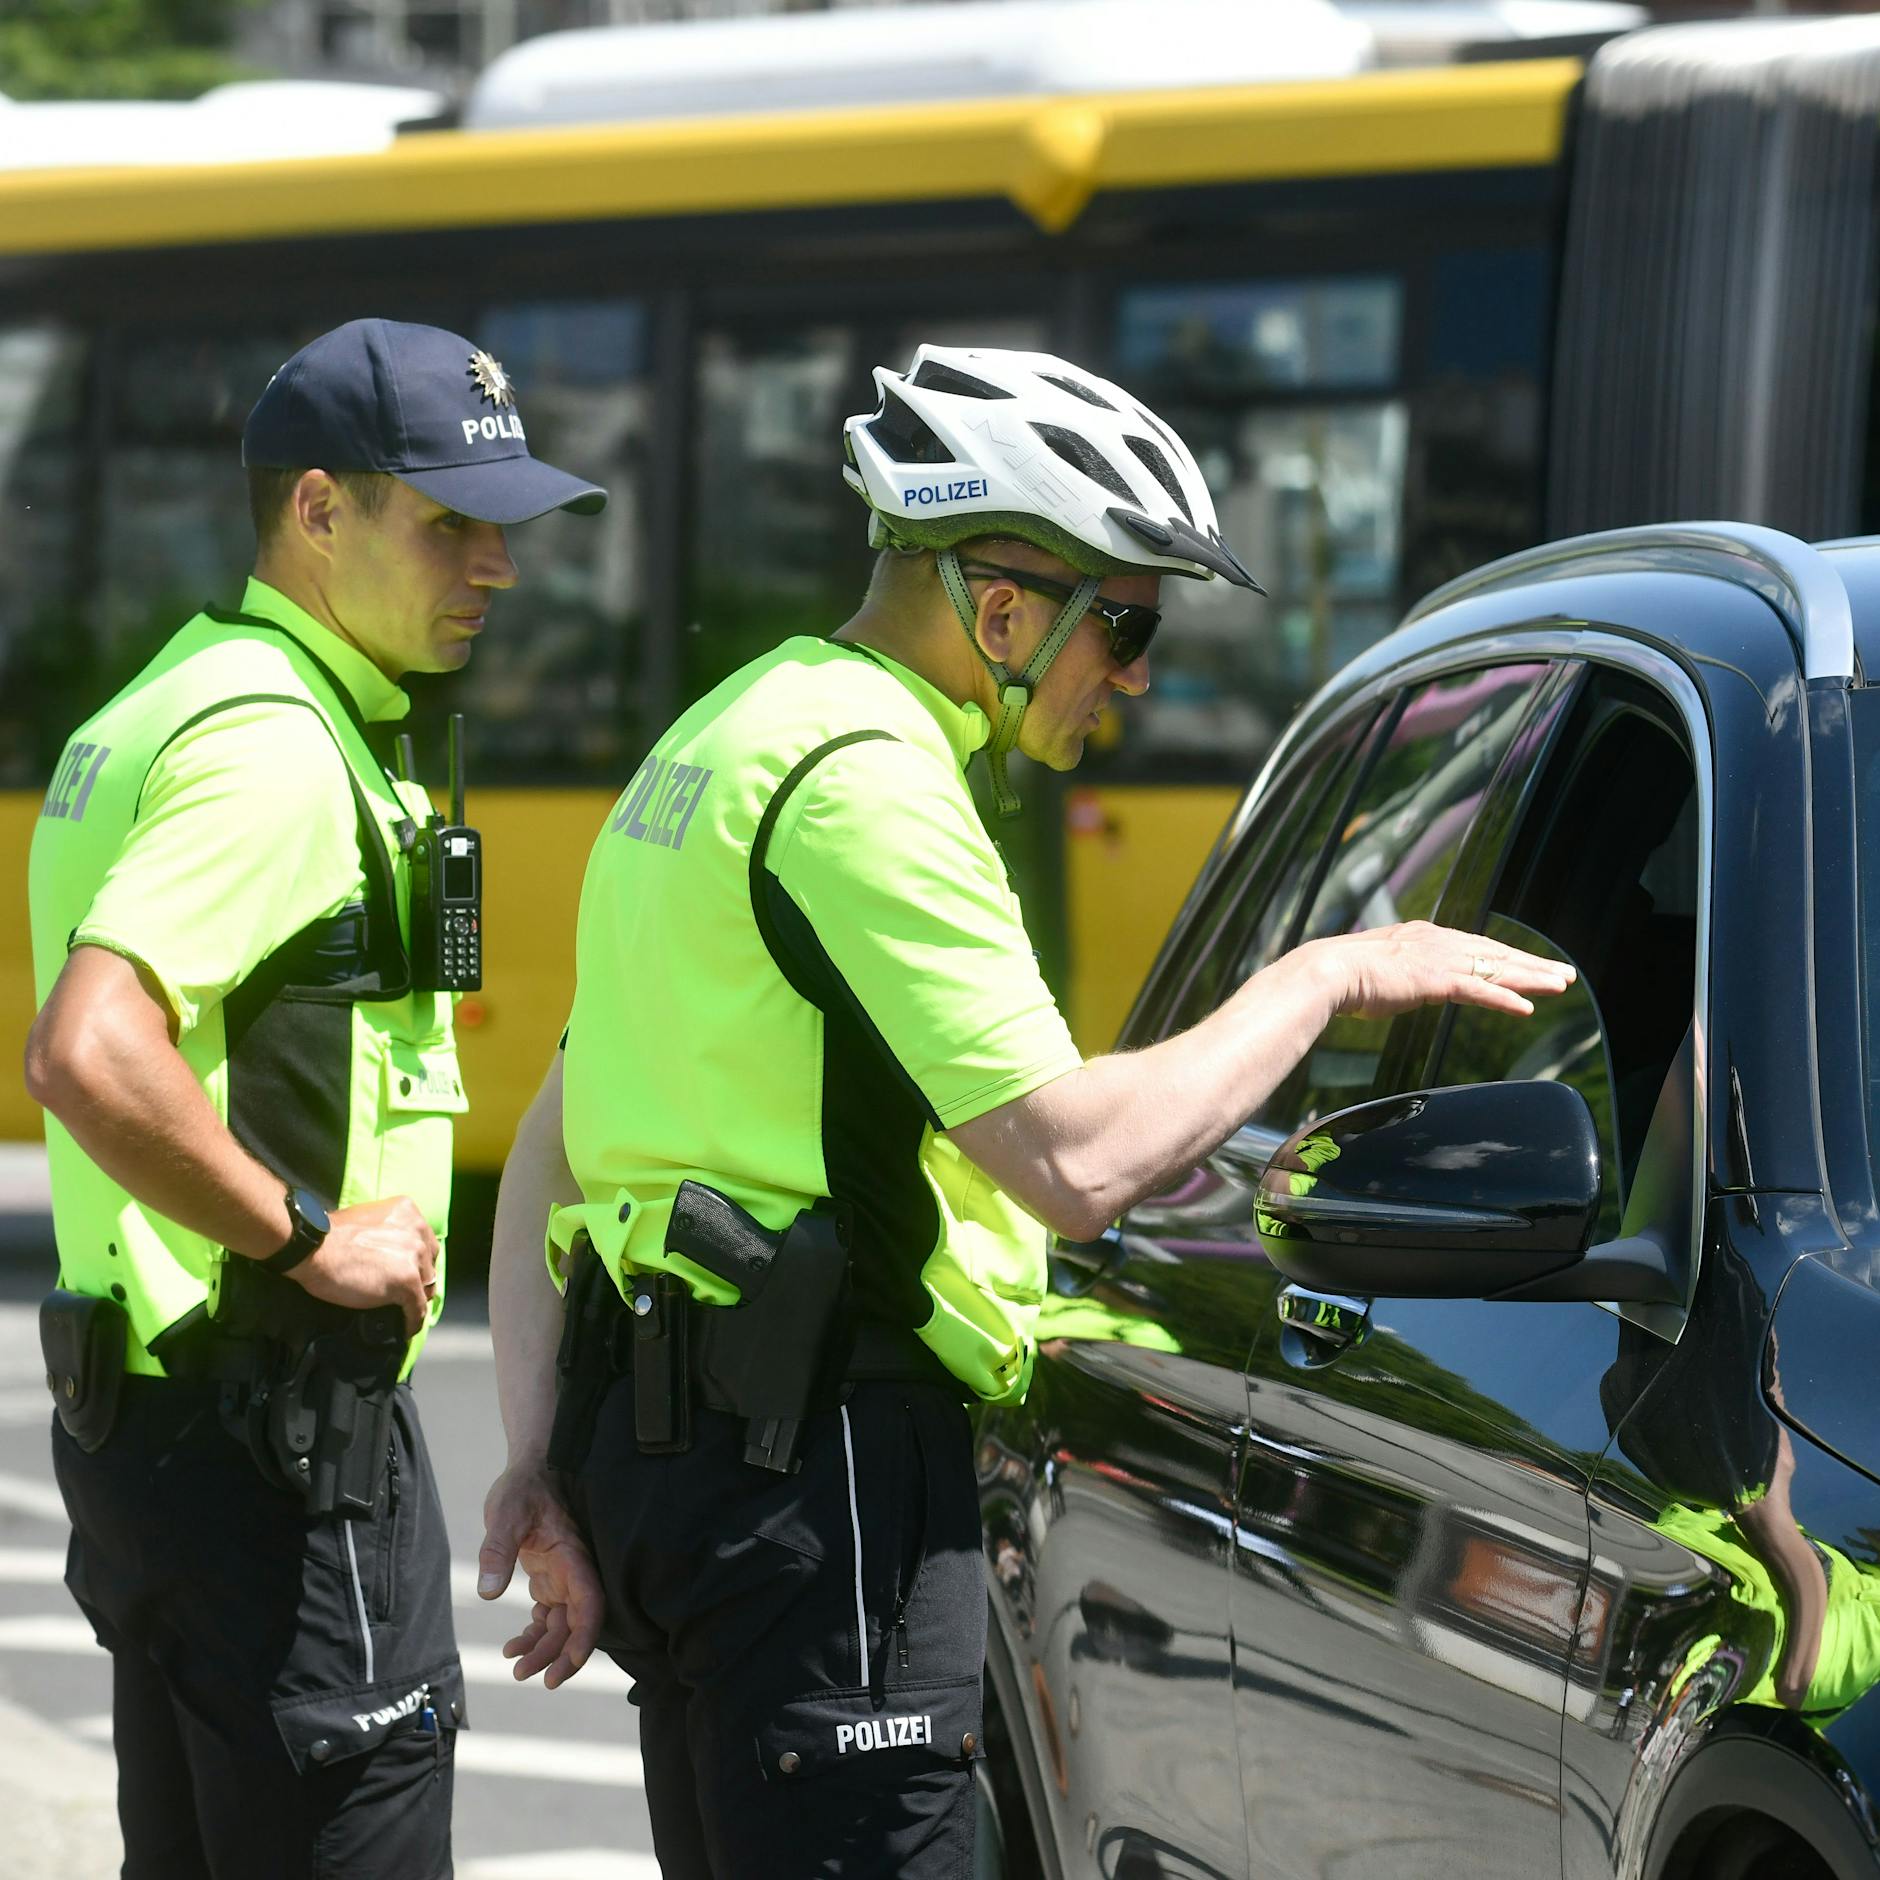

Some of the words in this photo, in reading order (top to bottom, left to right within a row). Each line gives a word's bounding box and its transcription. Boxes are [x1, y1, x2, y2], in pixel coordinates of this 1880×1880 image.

[904, 479, 988, 507] POLIZEI
[610, 754, 714, 851] OLIZEI
[836, 1715, 932, 1753] POLIZEI
